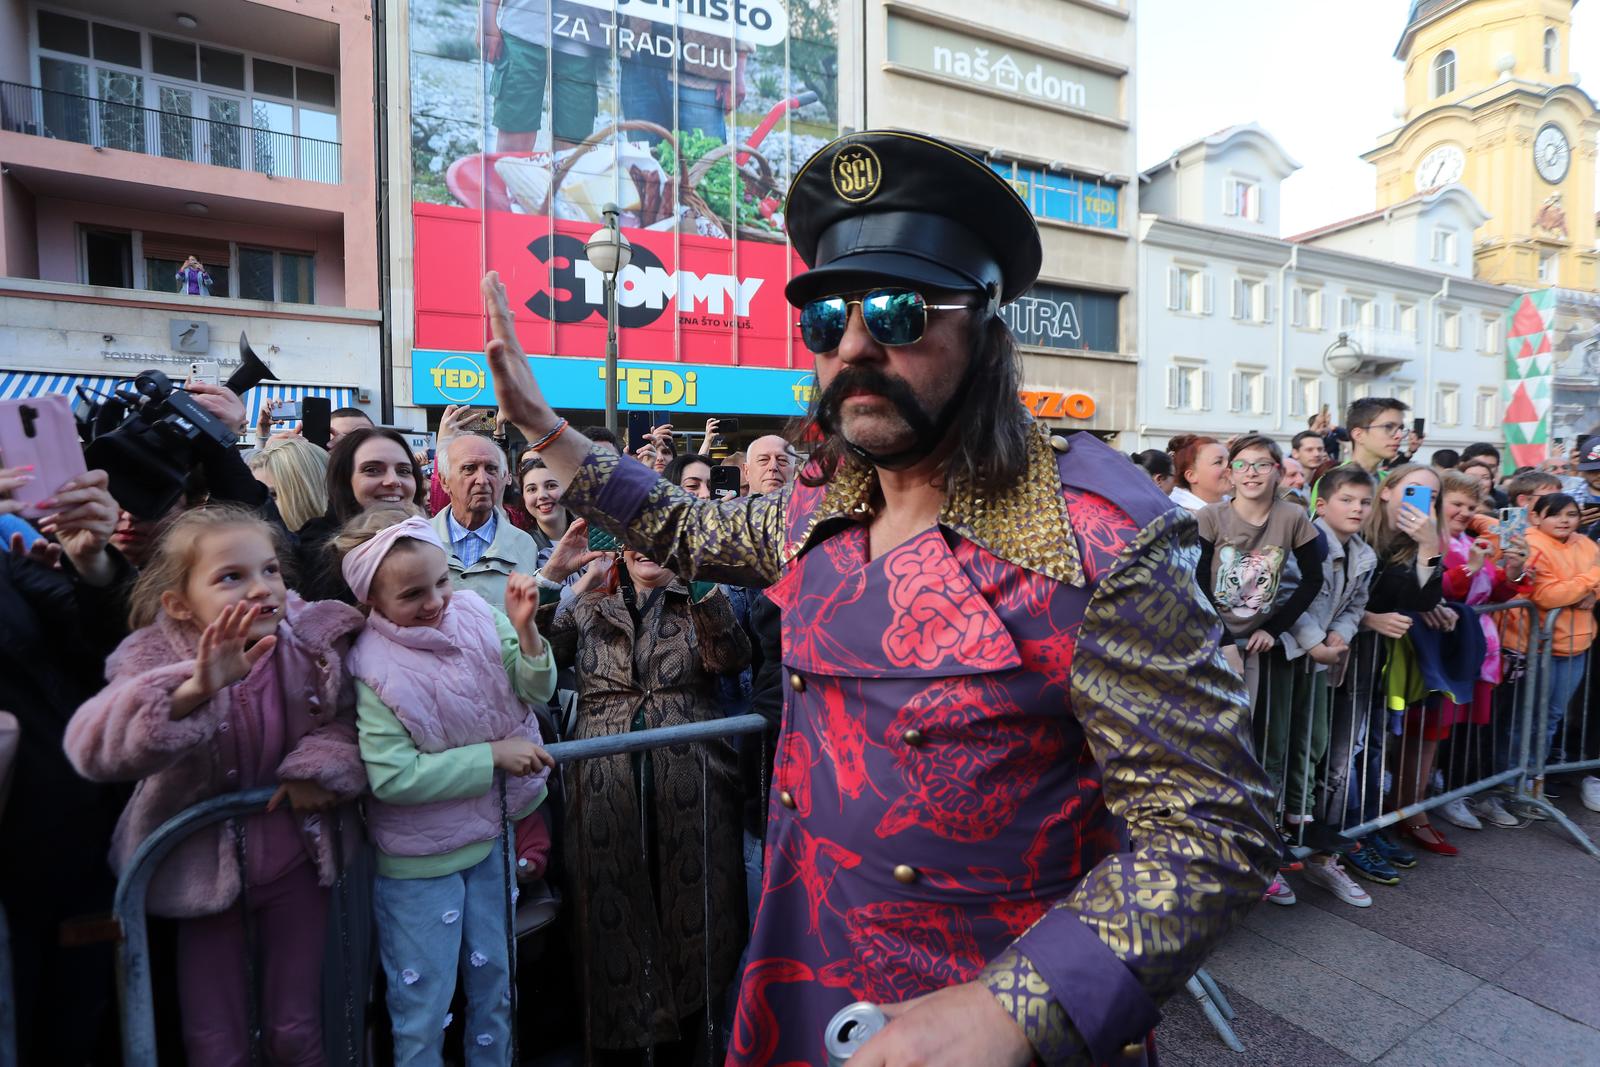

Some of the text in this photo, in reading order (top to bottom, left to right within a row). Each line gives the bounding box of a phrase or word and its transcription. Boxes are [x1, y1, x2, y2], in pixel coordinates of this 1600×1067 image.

[553, 12, 738, 71] ZA TRADICIJU
[933, 46, 1086, 107] naš dom
[575, 259, 765, 317] TOMMY
[679, 316, 699, 326] ZNA
[701, 316, 720, 327] ŠTO
[101, 351, 167, 364] TOURIST
[430, 367, 486, 390] TEDi
